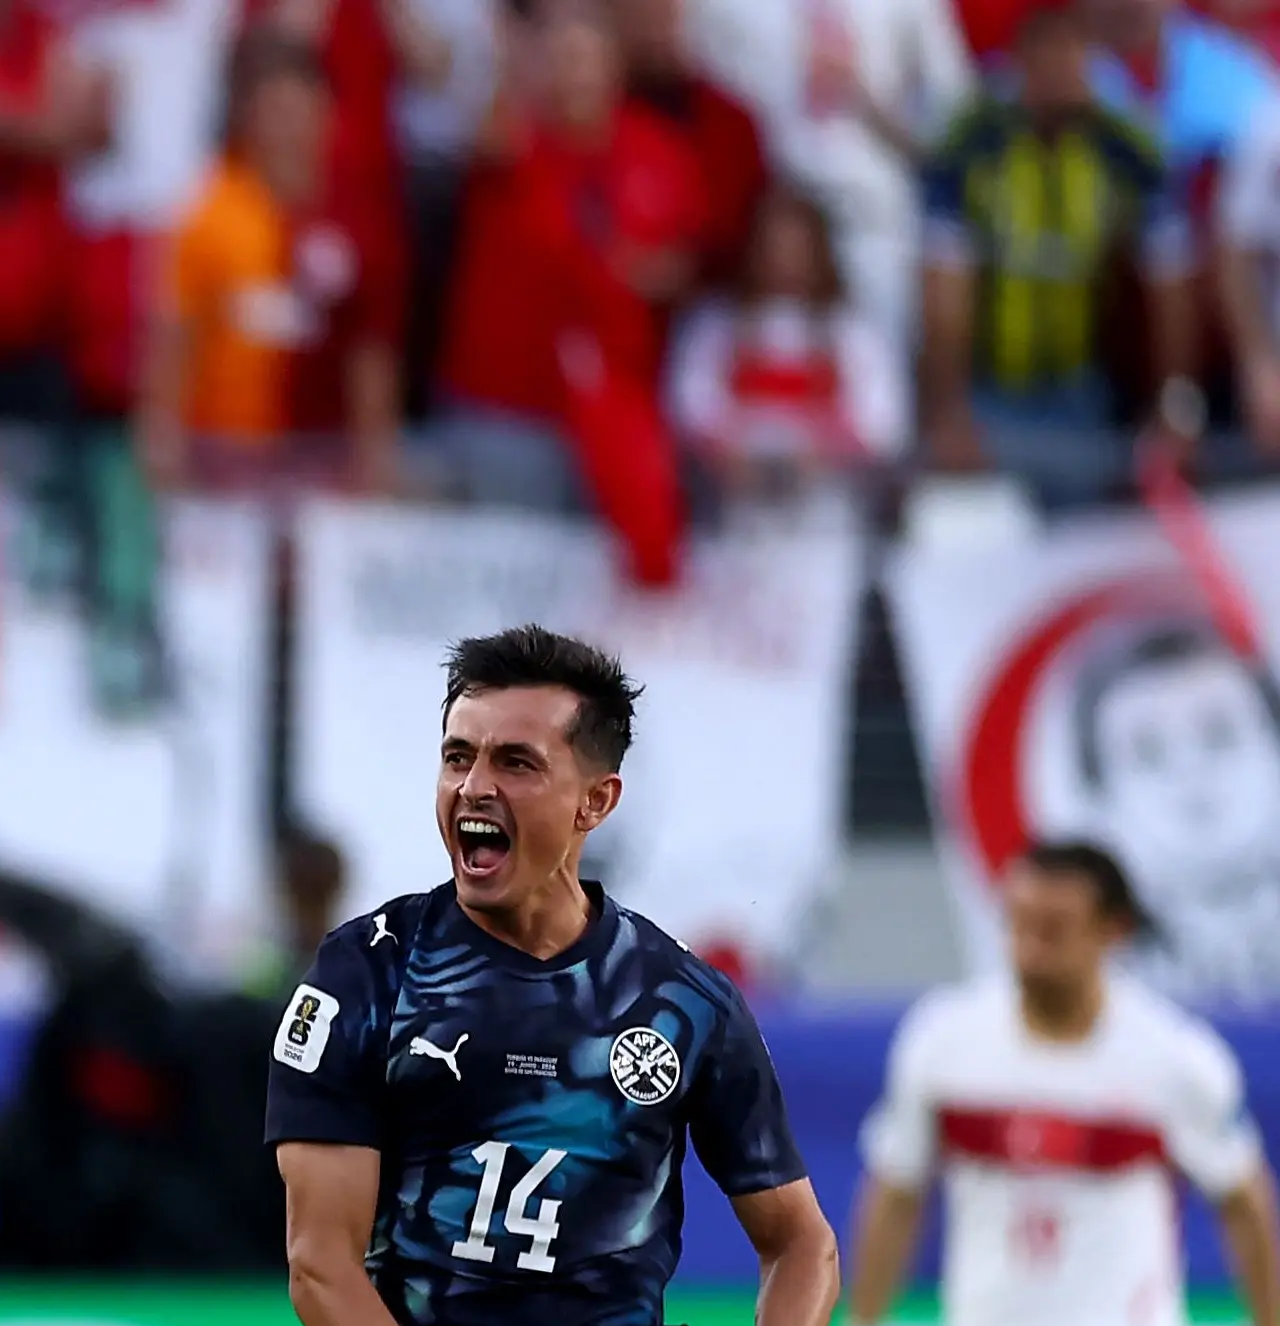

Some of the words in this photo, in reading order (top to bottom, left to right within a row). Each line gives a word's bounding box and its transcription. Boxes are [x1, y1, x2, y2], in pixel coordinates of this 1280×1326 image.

[633, 1033, 656, 1048] APF
[284, 1048, 303, 1063] 2026
[628, 1086, 659, 1100] PARAGUAY
[451, 1140, 568, 1274] 14
